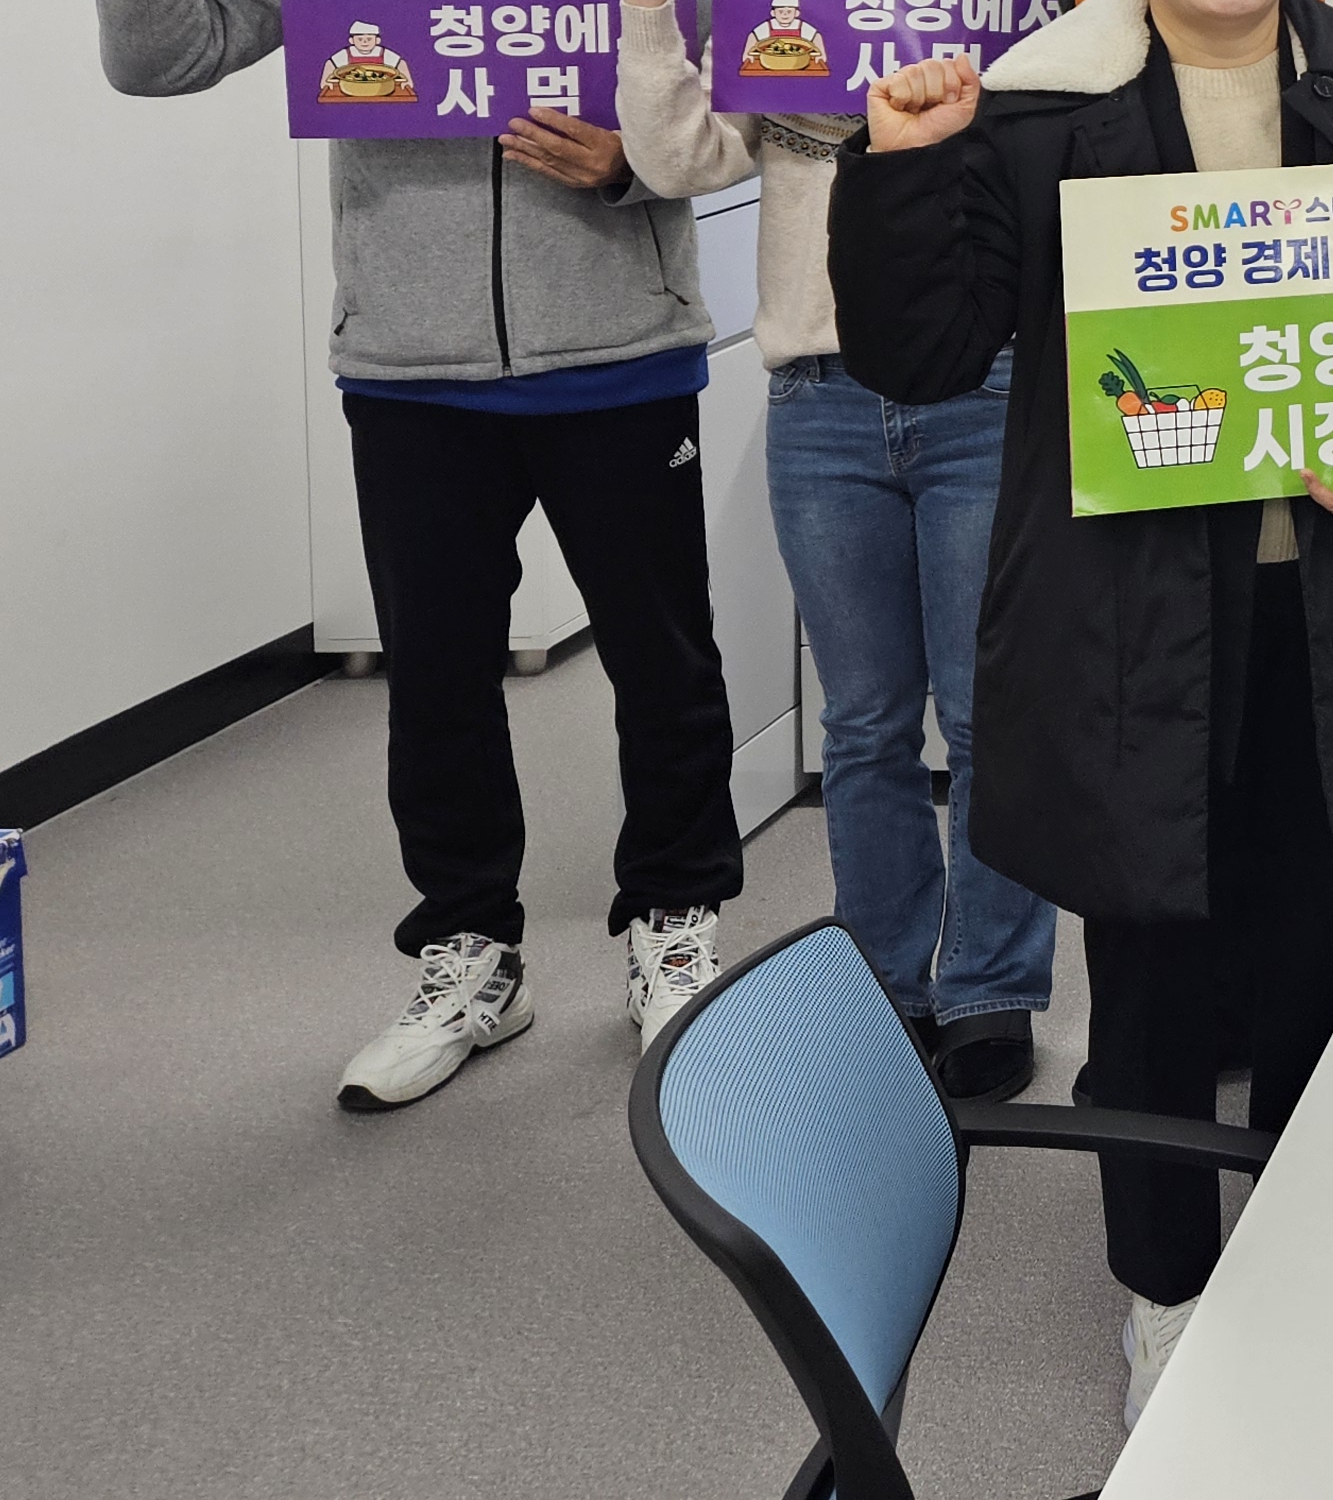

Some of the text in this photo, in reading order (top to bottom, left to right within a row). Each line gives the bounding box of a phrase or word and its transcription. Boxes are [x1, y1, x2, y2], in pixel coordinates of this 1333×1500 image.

[429, 2, 619, 57] 청양에
[1133, 242, 1226, 292] 청양
[1241, 235, 1330, 284] 경제
